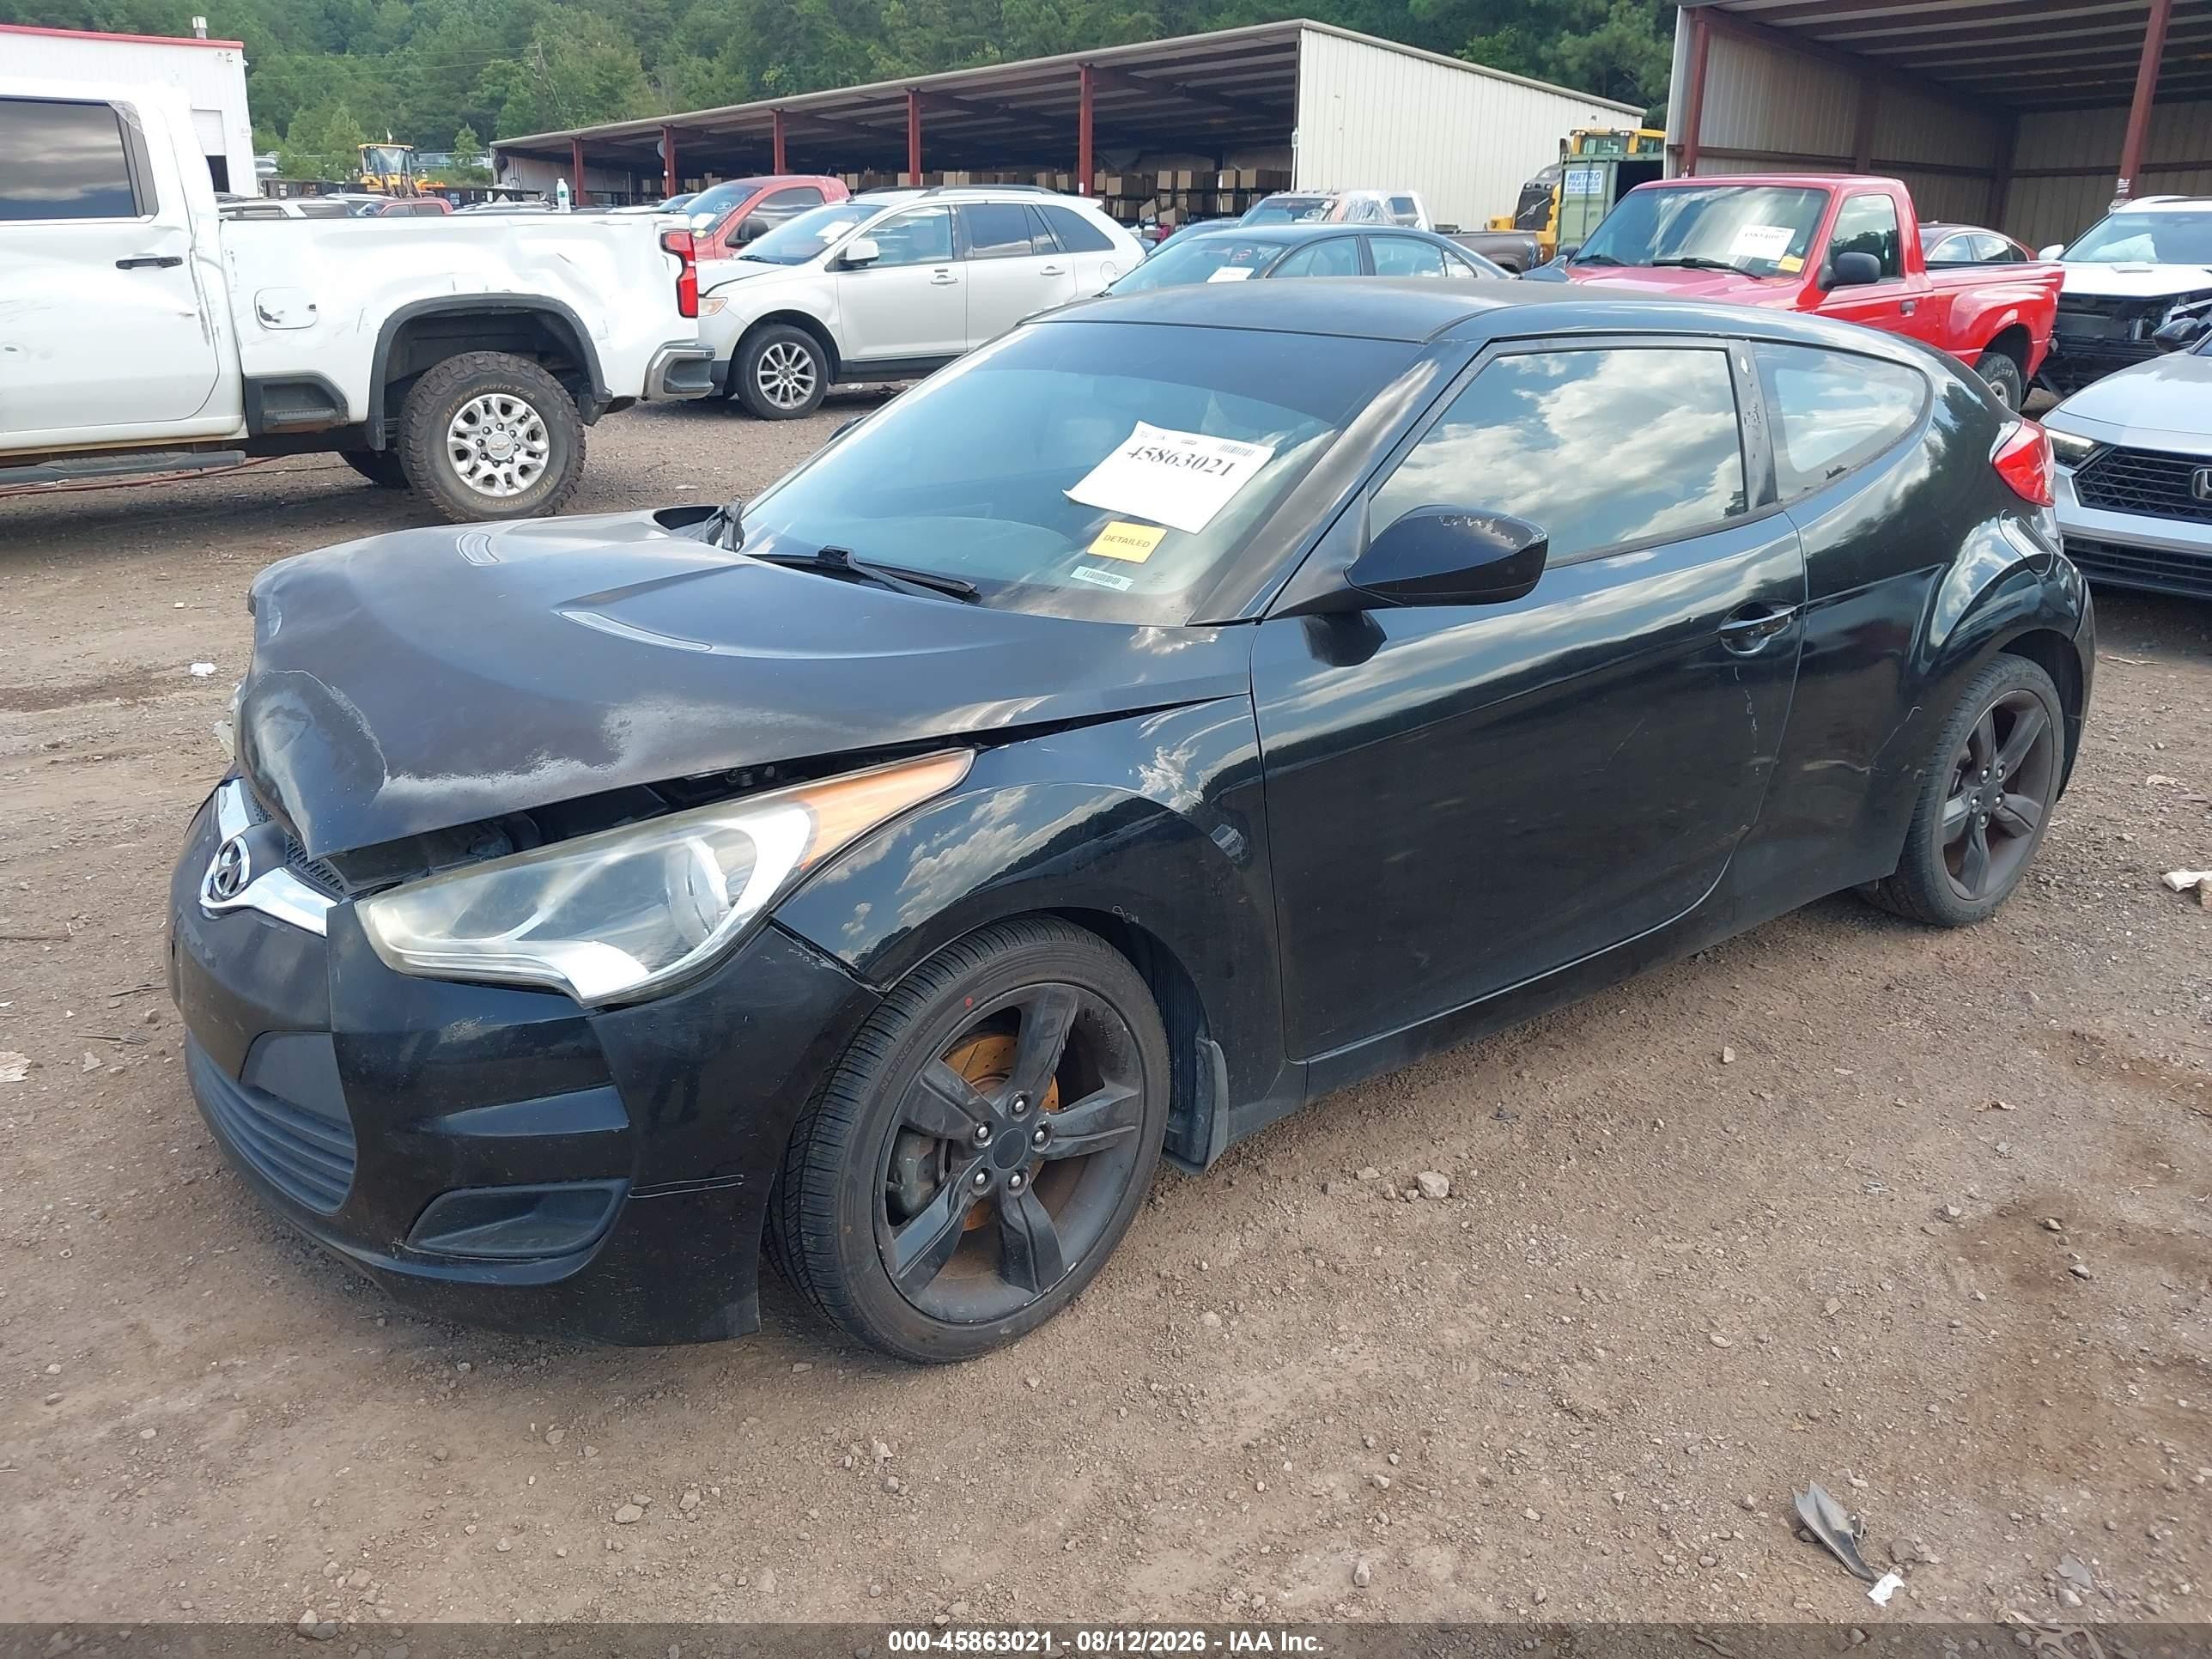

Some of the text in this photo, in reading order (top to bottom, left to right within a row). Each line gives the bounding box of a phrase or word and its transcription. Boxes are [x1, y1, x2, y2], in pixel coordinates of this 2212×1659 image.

[1568, 172, 1601, 180] METRO
[1127, 446, 1236, 477] 45863021
[1103, 534, 1152, 548] DETAILED
